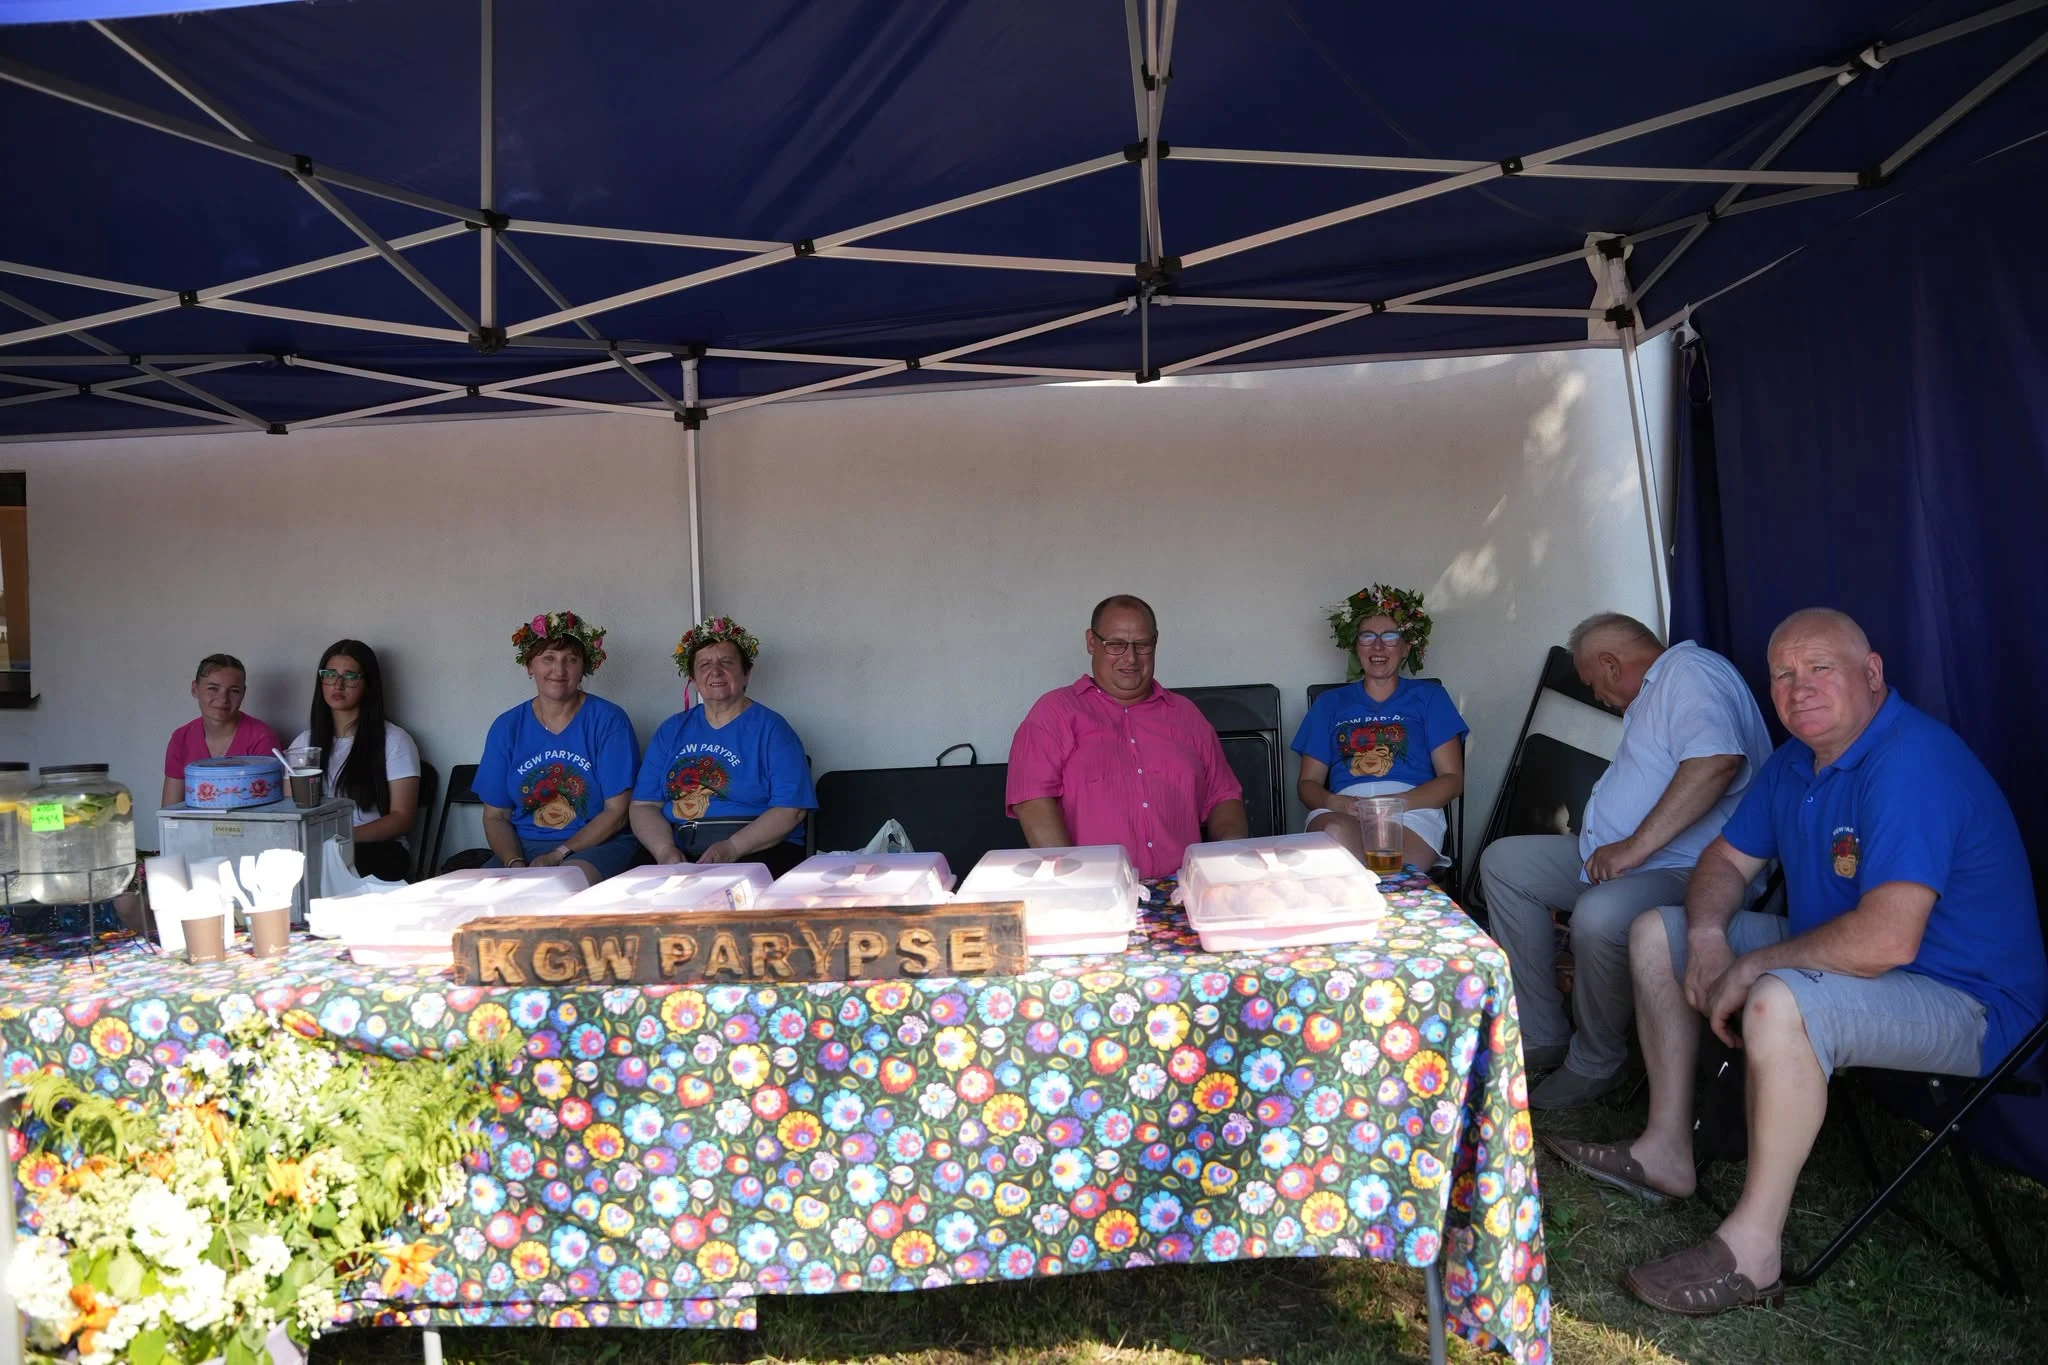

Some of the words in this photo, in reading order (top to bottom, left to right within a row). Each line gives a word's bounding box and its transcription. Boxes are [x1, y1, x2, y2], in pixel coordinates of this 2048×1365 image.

[517, 754, 542, 775] KGW
[545, 750, 592, 771] PARYPSE
[700, 743, 741, 767] PARYPSE
[477, 935, 640, 984] KGW
[657, 926, 996, 979] PARYPSE
